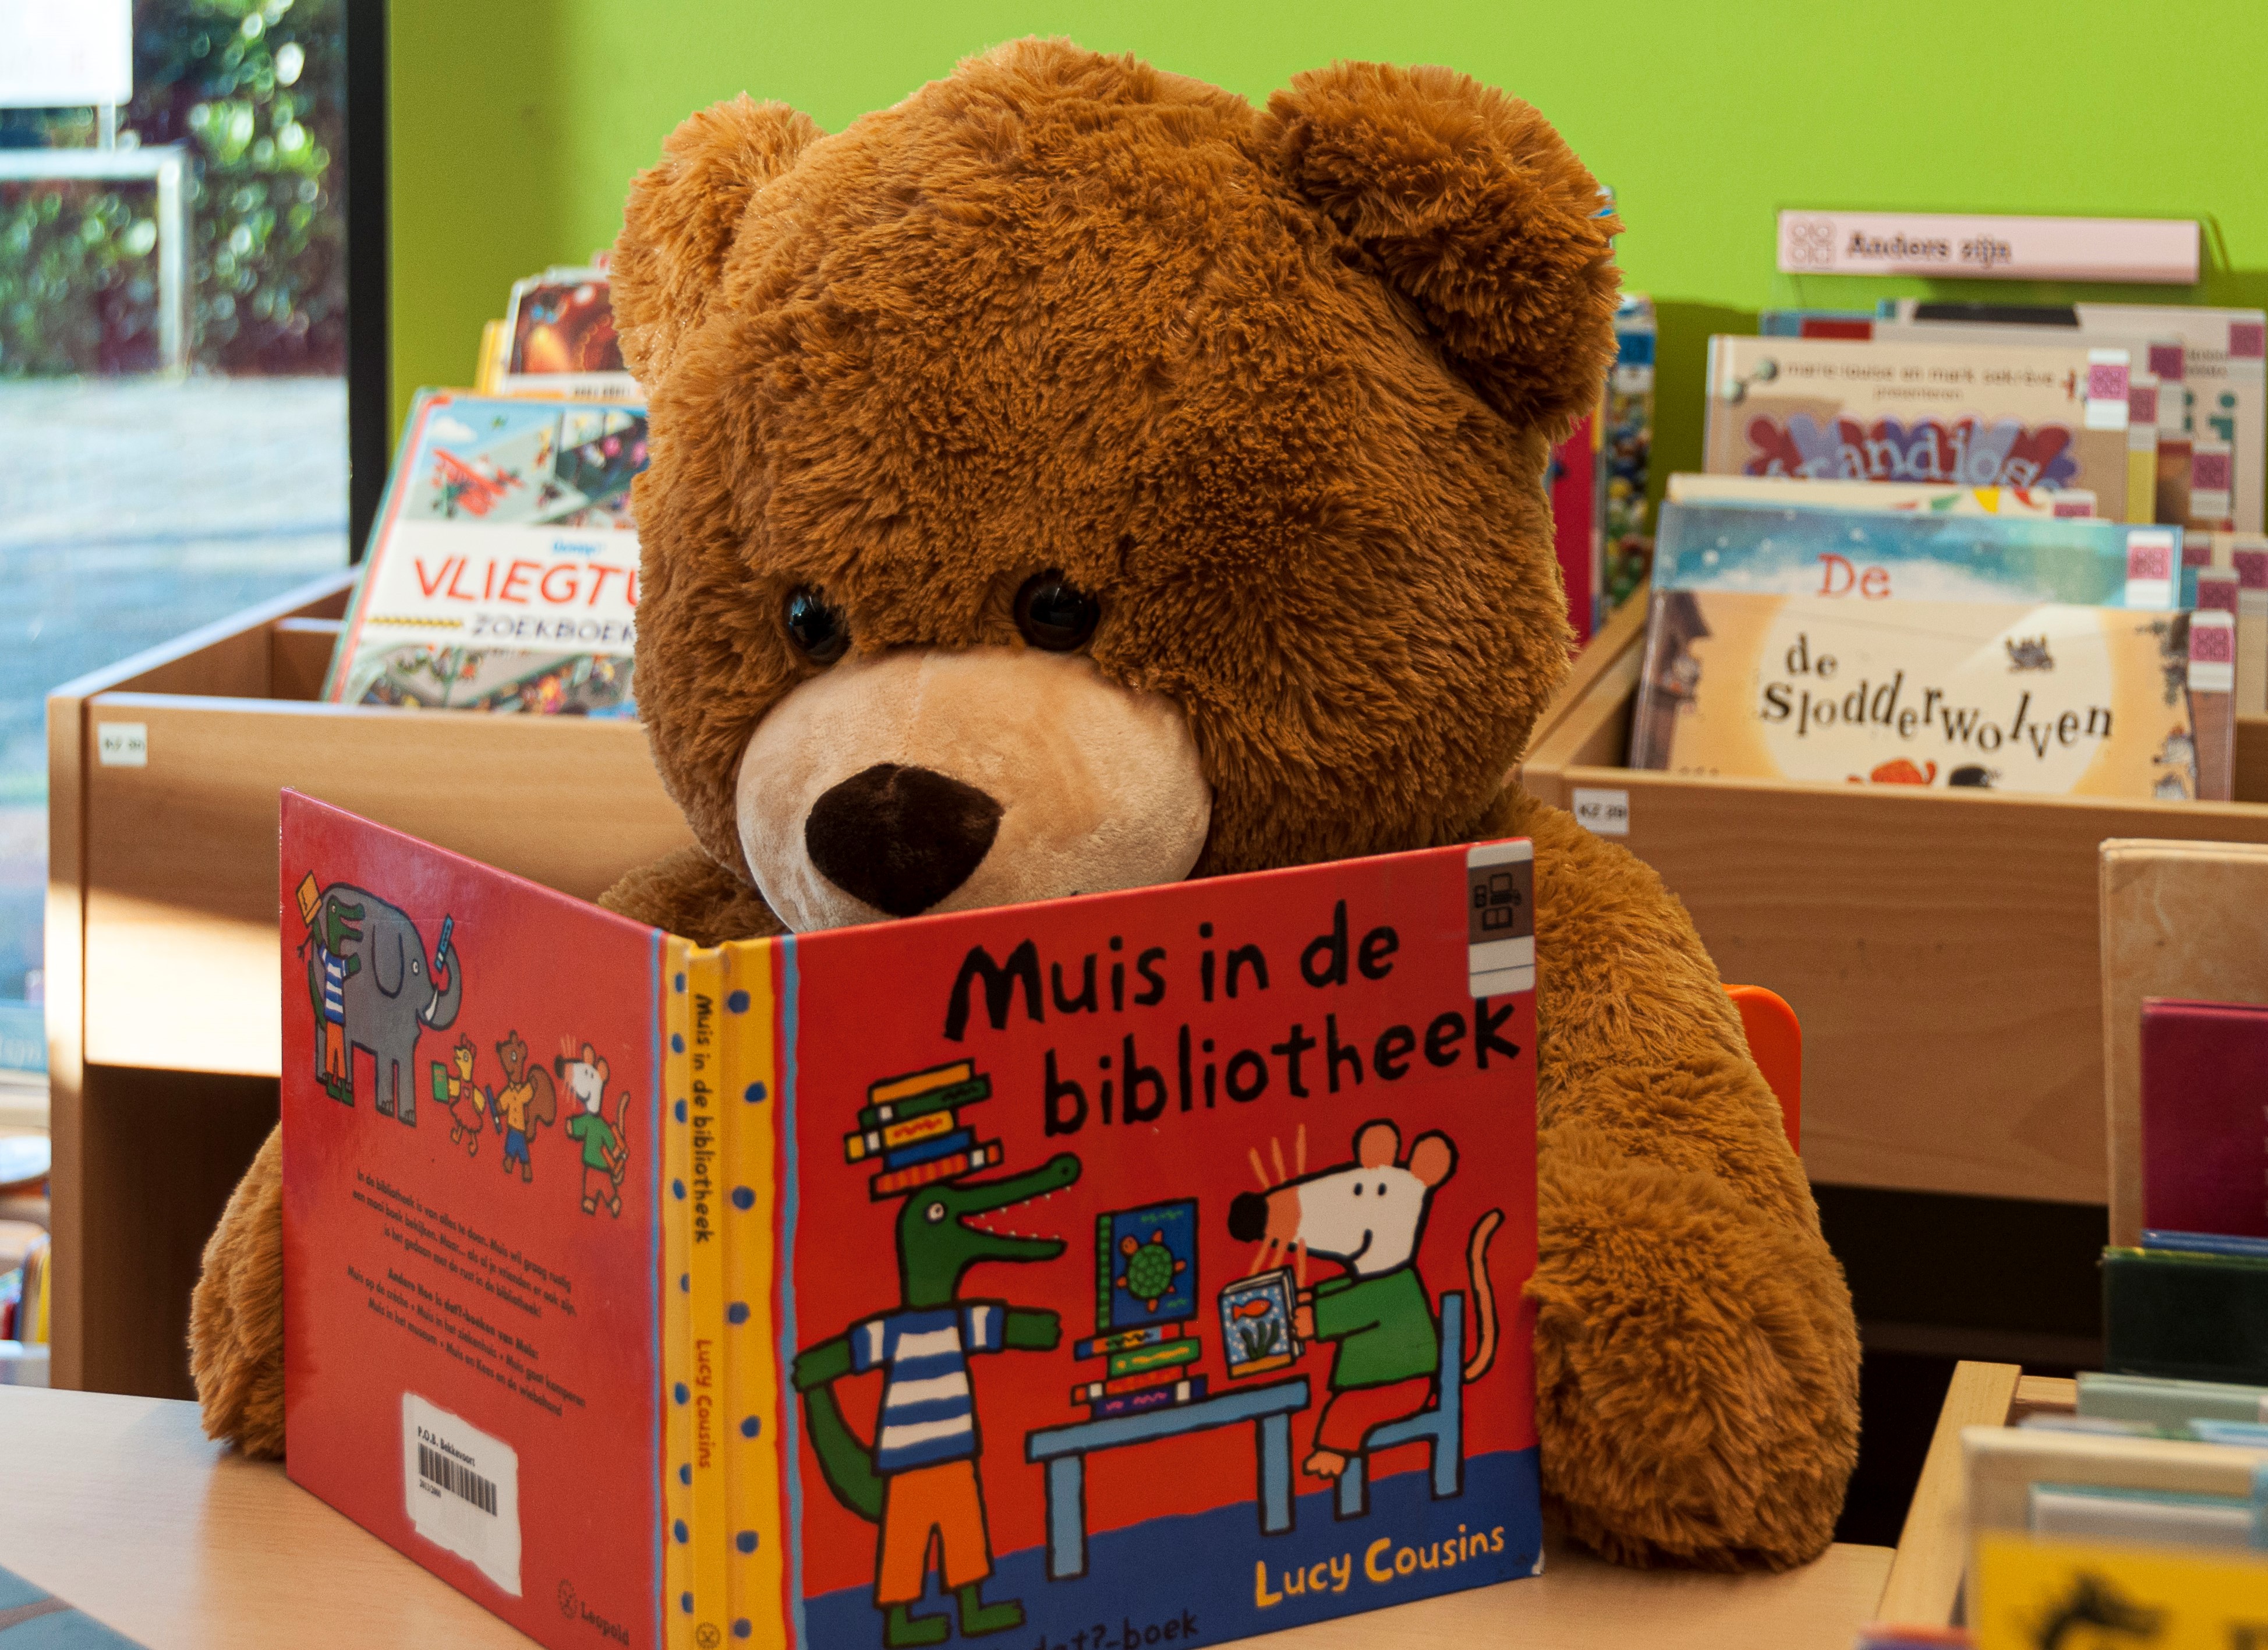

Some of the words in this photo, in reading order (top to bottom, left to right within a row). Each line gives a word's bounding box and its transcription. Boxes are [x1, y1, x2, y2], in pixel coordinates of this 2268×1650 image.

[1818, 553, 1891, 600] De
[1785, 633, 1838, 677] de
[943, 935, 1166, 1042] Muis
[1198, 922, 1269, 1003] in
[1300, 899, 1399, 988] de
[694, 994, 713, 1046] Muis
[693, 1053, 713, 1070] in
[1045, 996, 1521, 1137] bibliotheek
[692, 1080, 713, 1108] de
[692, 1116, 716, 1244] bibliotheek
[695, 1339, 713, 1390] Lucy
[417, 1425, 438, 1447] P.O.B.
[696, 1395, 716, 1469] Cousins
[1254, 1552, 1352, 1608] Lucy
[1364, 1524, 1506, 1584] Cousins
[581, 1600, 629, 1645] Leopold
